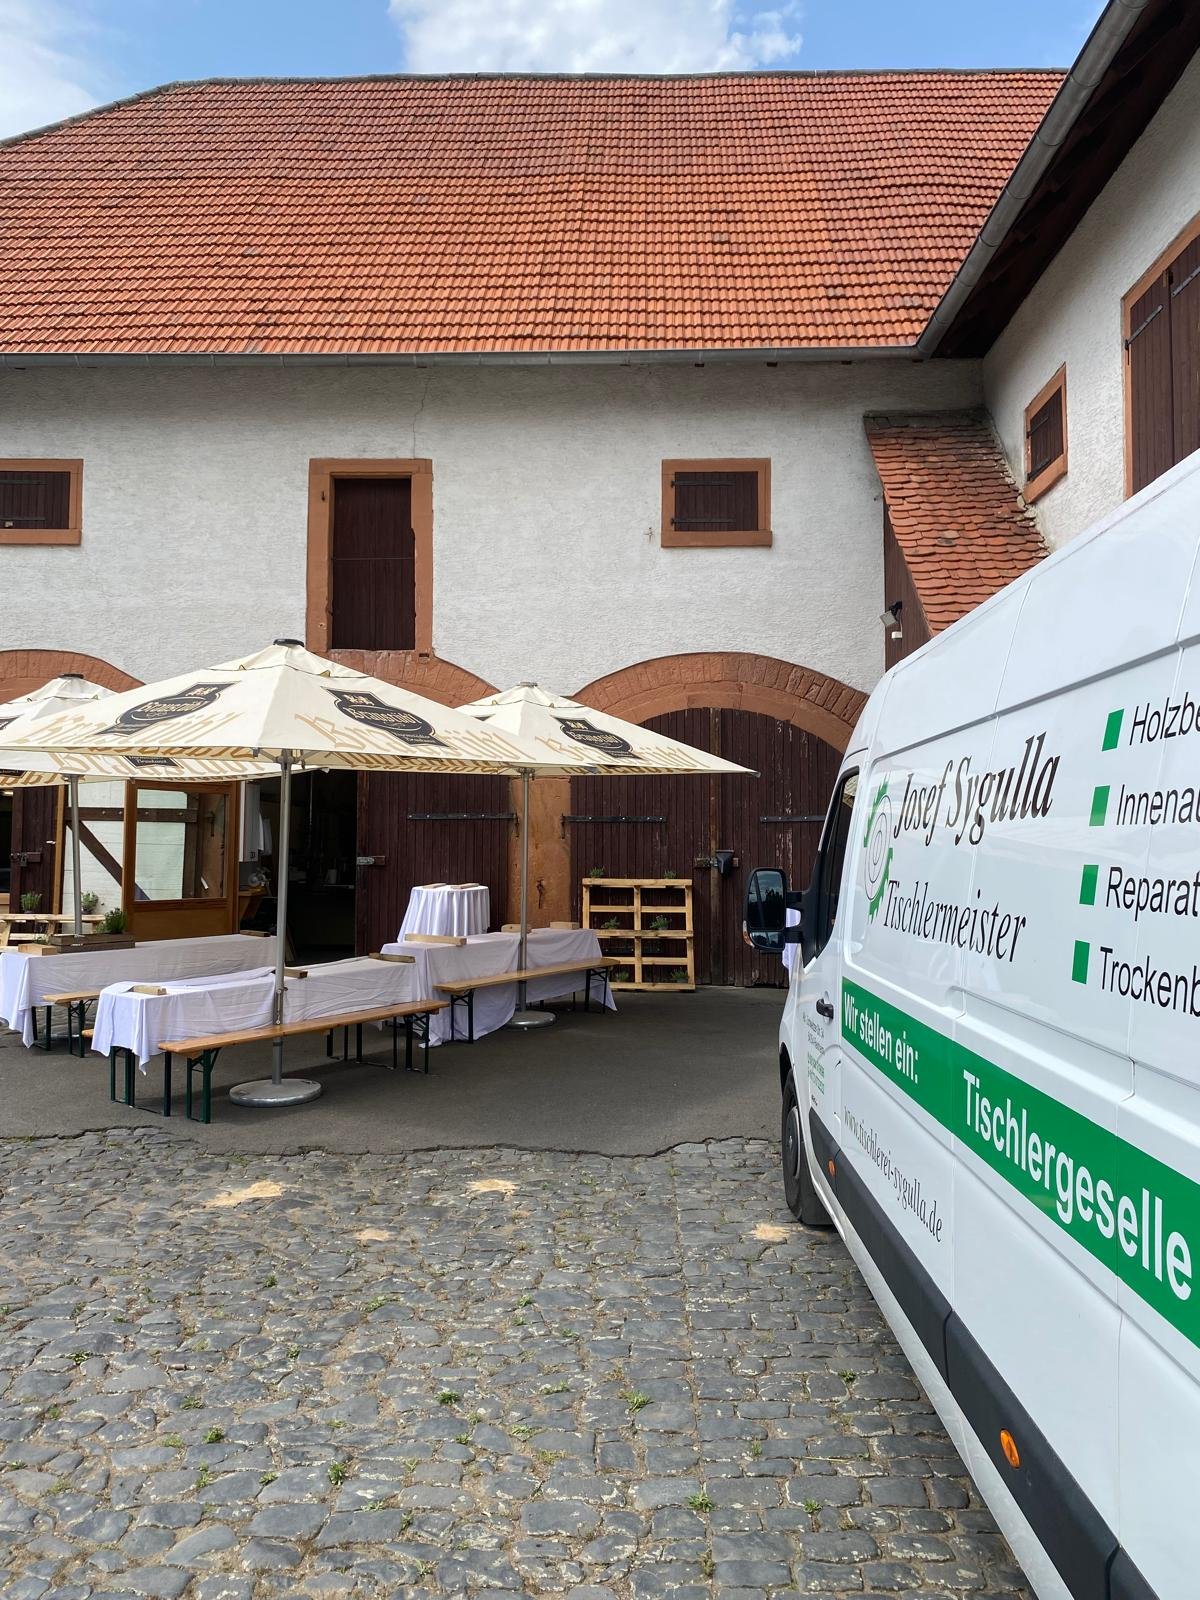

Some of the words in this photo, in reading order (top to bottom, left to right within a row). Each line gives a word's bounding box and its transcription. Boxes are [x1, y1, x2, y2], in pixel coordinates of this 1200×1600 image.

[893, 758, 954, 847] Josef
[944, 730, 1061, 846] Sygulla
[883, 879, 1027, 963] Tischlermeister
[1105, 866, 1200, 922] Reparat
[1099, 945, 1200, 1018] Trockenb
[843, 991, 858, 1034] Wir
[859, 1006, 893, 1064] stellen
[894, 1030, 919, 1085] ein:
[843, 1104, 943, 1244] www.tischlerei-sygulla.de
[963, 1068, 1193, 1302] Tischlergeselle
